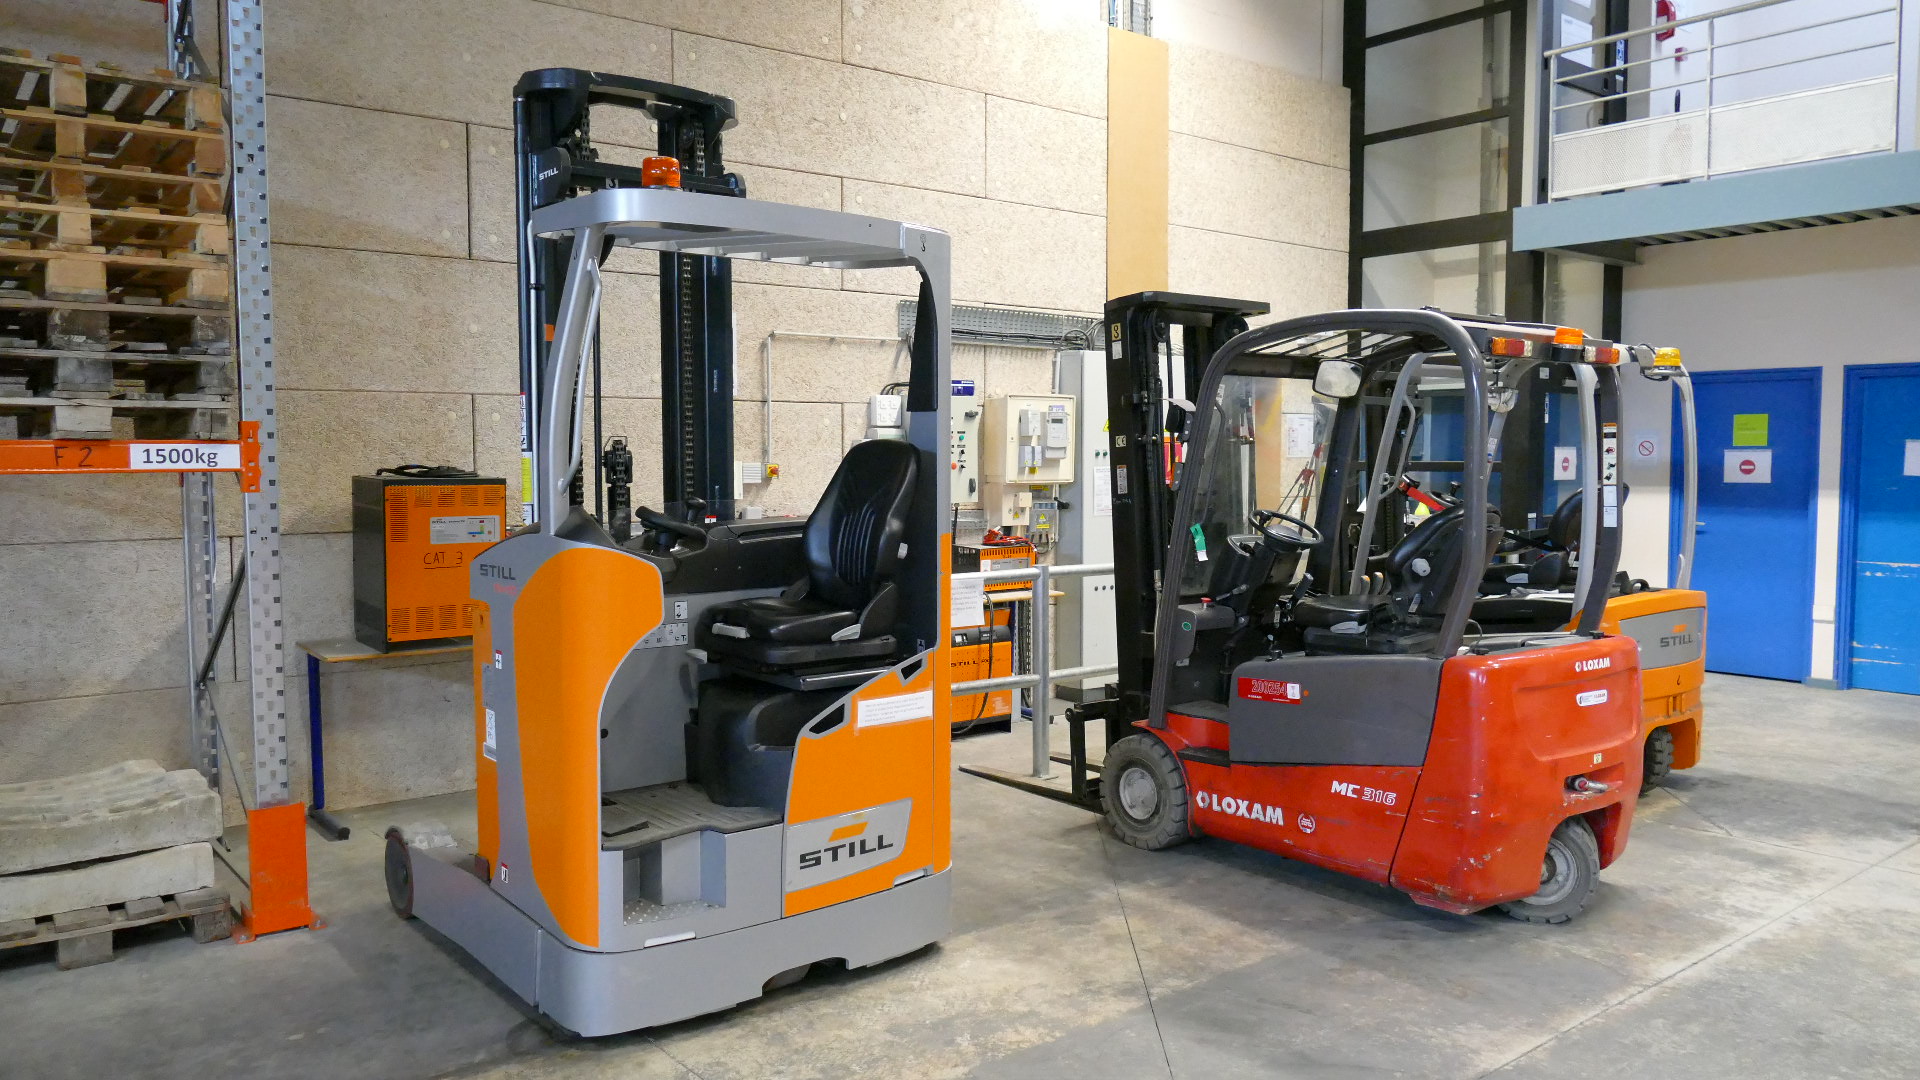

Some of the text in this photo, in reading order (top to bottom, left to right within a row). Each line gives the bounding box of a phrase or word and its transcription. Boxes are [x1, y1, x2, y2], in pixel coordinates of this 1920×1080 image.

[538, 167, 559, 181] STILL
[54, 446, 93, 467] F 2
[142, 448, 218, 467] 1500kg
[423, 550, 463, 565] CAT 3
[480, 563, 516, 580] STILL
[1660, 634, 1693, 648] STILL
[1583, 657, 1610, 672] LOXAM
[1331, 780, 1397, 806] MC 316
[1212, 793, 1284, 826] LOXAM
[800, 834, 893, 870] STILL
